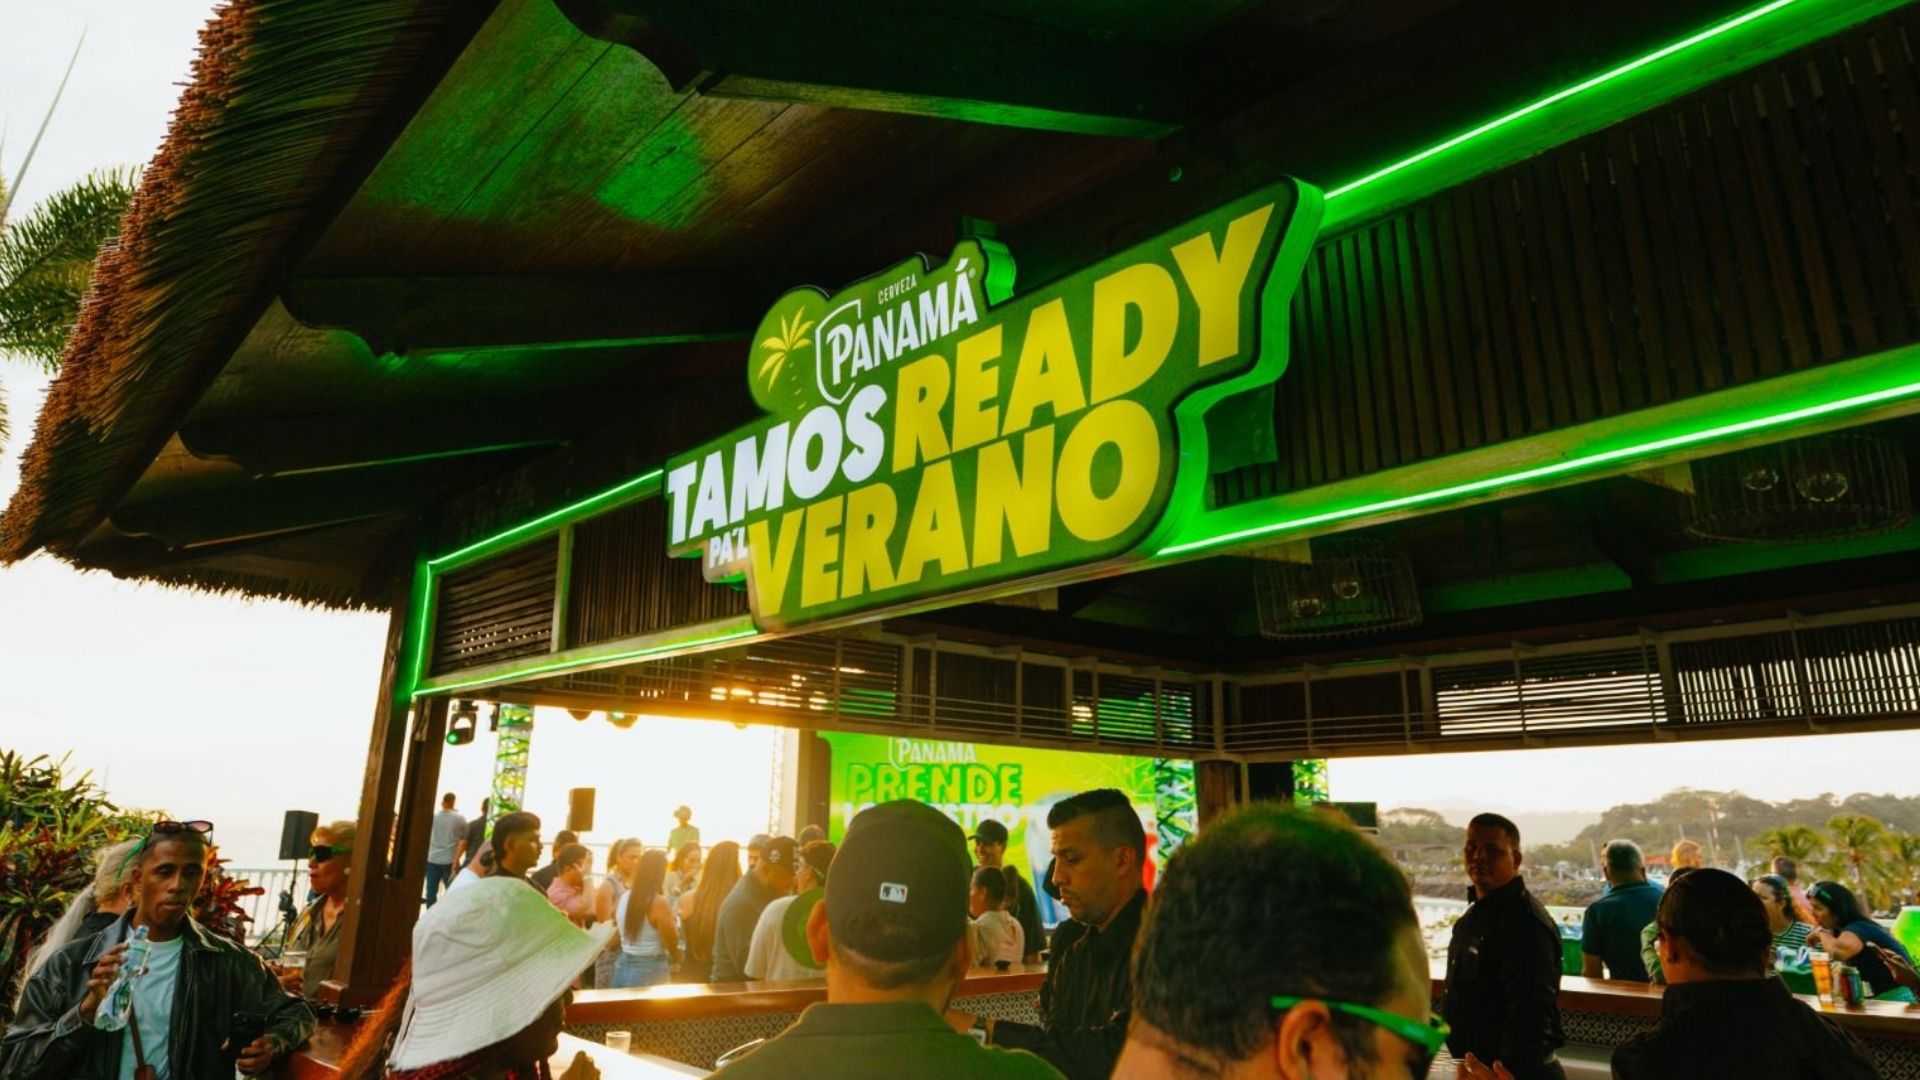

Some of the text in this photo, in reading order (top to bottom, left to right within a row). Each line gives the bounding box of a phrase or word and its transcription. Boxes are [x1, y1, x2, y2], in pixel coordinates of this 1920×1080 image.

[826, 258, 978, 386] PANAMÁ
[878, 274, 917, 305] CERVEZA
[667, 202, 1275, 545] TAMOS READY
[747, 399, 1160, 618] VERANO
[849, 763, 1022, 806] PRENDE
